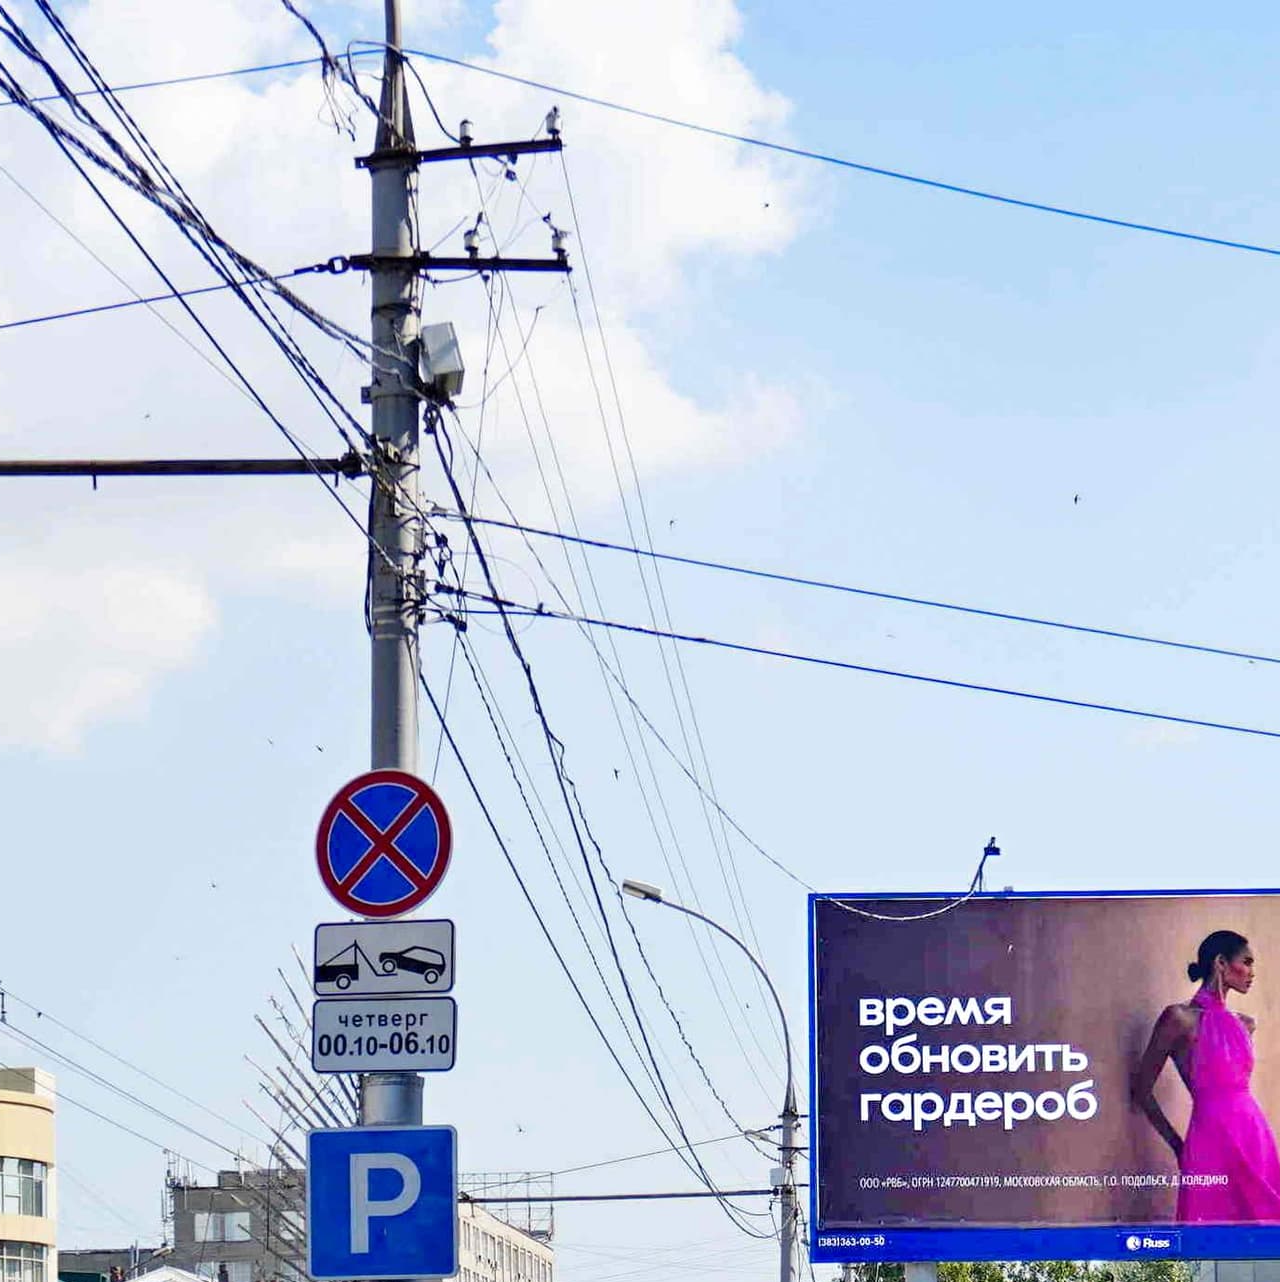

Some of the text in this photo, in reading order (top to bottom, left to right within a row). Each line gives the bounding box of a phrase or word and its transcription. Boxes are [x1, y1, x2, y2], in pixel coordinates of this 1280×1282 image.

[338, 1012, 428, 1031] четверг
[859, 996, 1012, 1036] время
[318, 1031, 450, 1056] 00.10-06.10
[859, 1033, 1089, 1075] обновить
[860, 1079, 1098, 1131] гардероб
[859, 1177, 880, 1189] ООО
[912, 1176, 934, 1188] ОГРН
[1004, 1176, 1062, 1187] МОСКОВСКАЯ
[1181, 1174, 1229, 1186] КОЛЕДИНО
[350, 1152, 421, 1254] P
[1143, 1238, 1170, 1248] Russ
